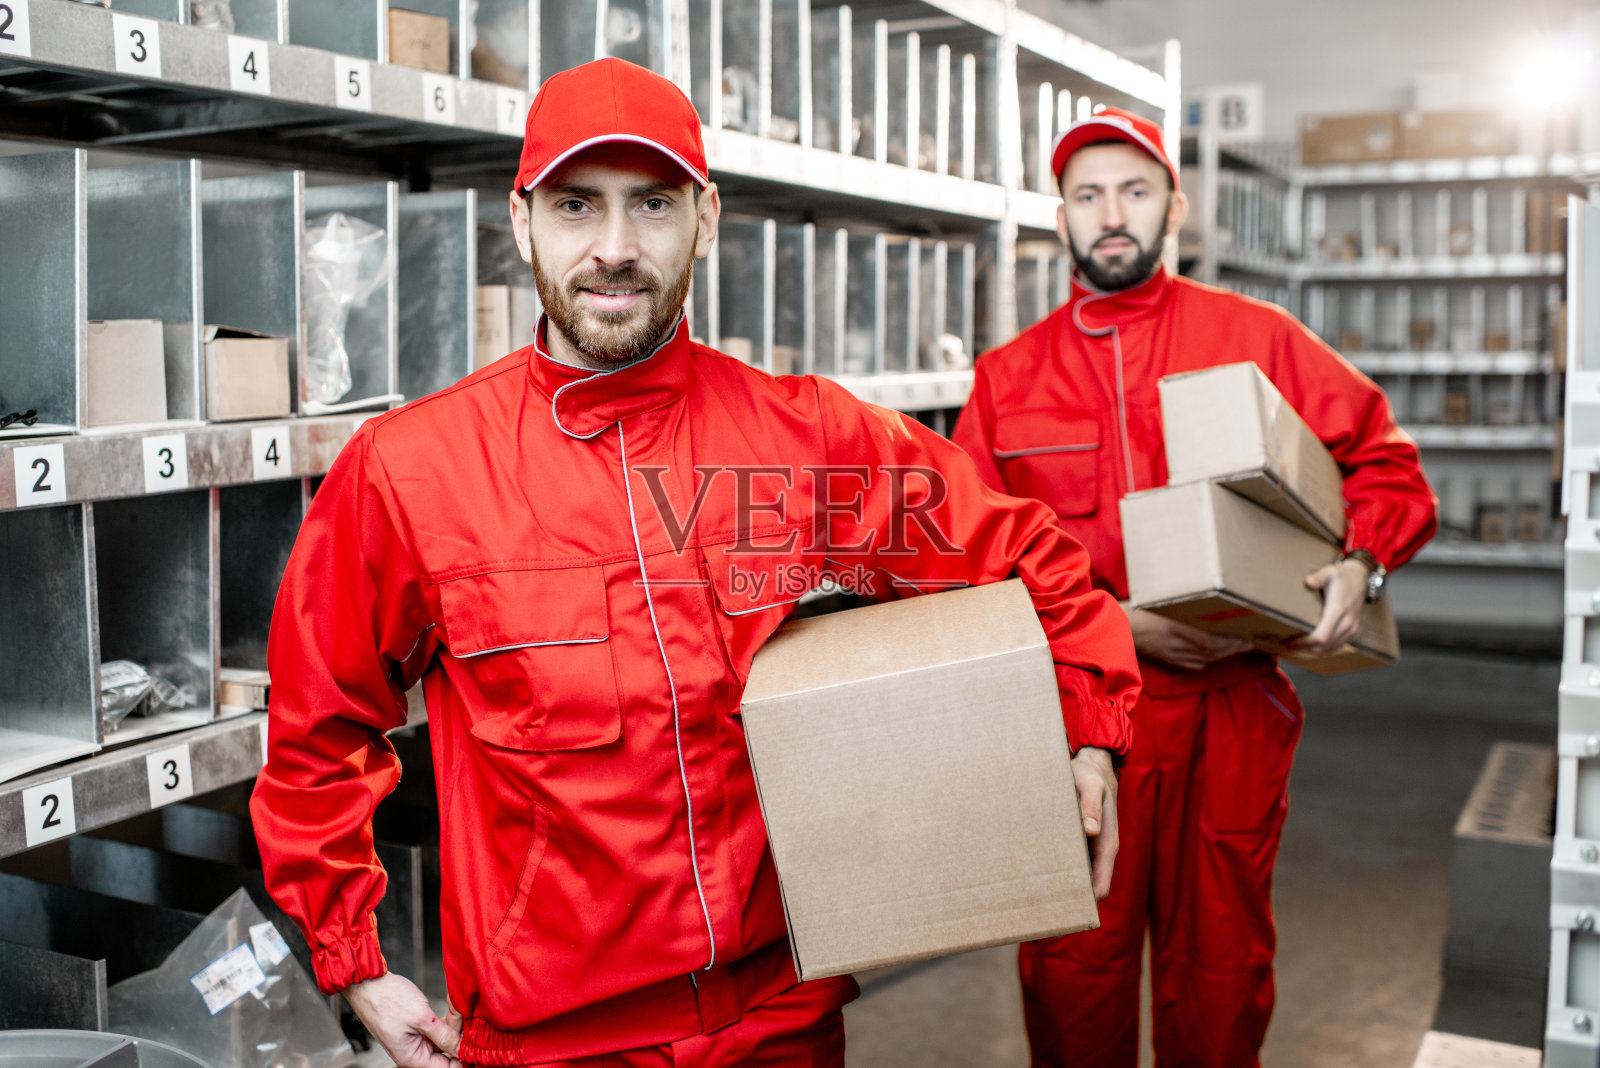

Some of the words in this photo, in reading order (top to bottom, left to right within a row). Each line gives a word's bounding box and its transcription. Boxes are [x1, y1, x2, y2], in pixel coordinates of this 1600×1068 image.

[0, 4, 15, 41] 2
[130, 30, 148, 62] 3
[243, 51, 258, 81] 4
[348, 70, 361, 98] 5
[433, 85, 446, 113] 6
[506, 98, 518, 125] 7
[158, 448, 175, 479] 3
[265, 438, 280, 466] 4
[31, 458, 51, 492] 2
[162, 760, 180, 790] 3
[41, 793, 61, 829] 2
